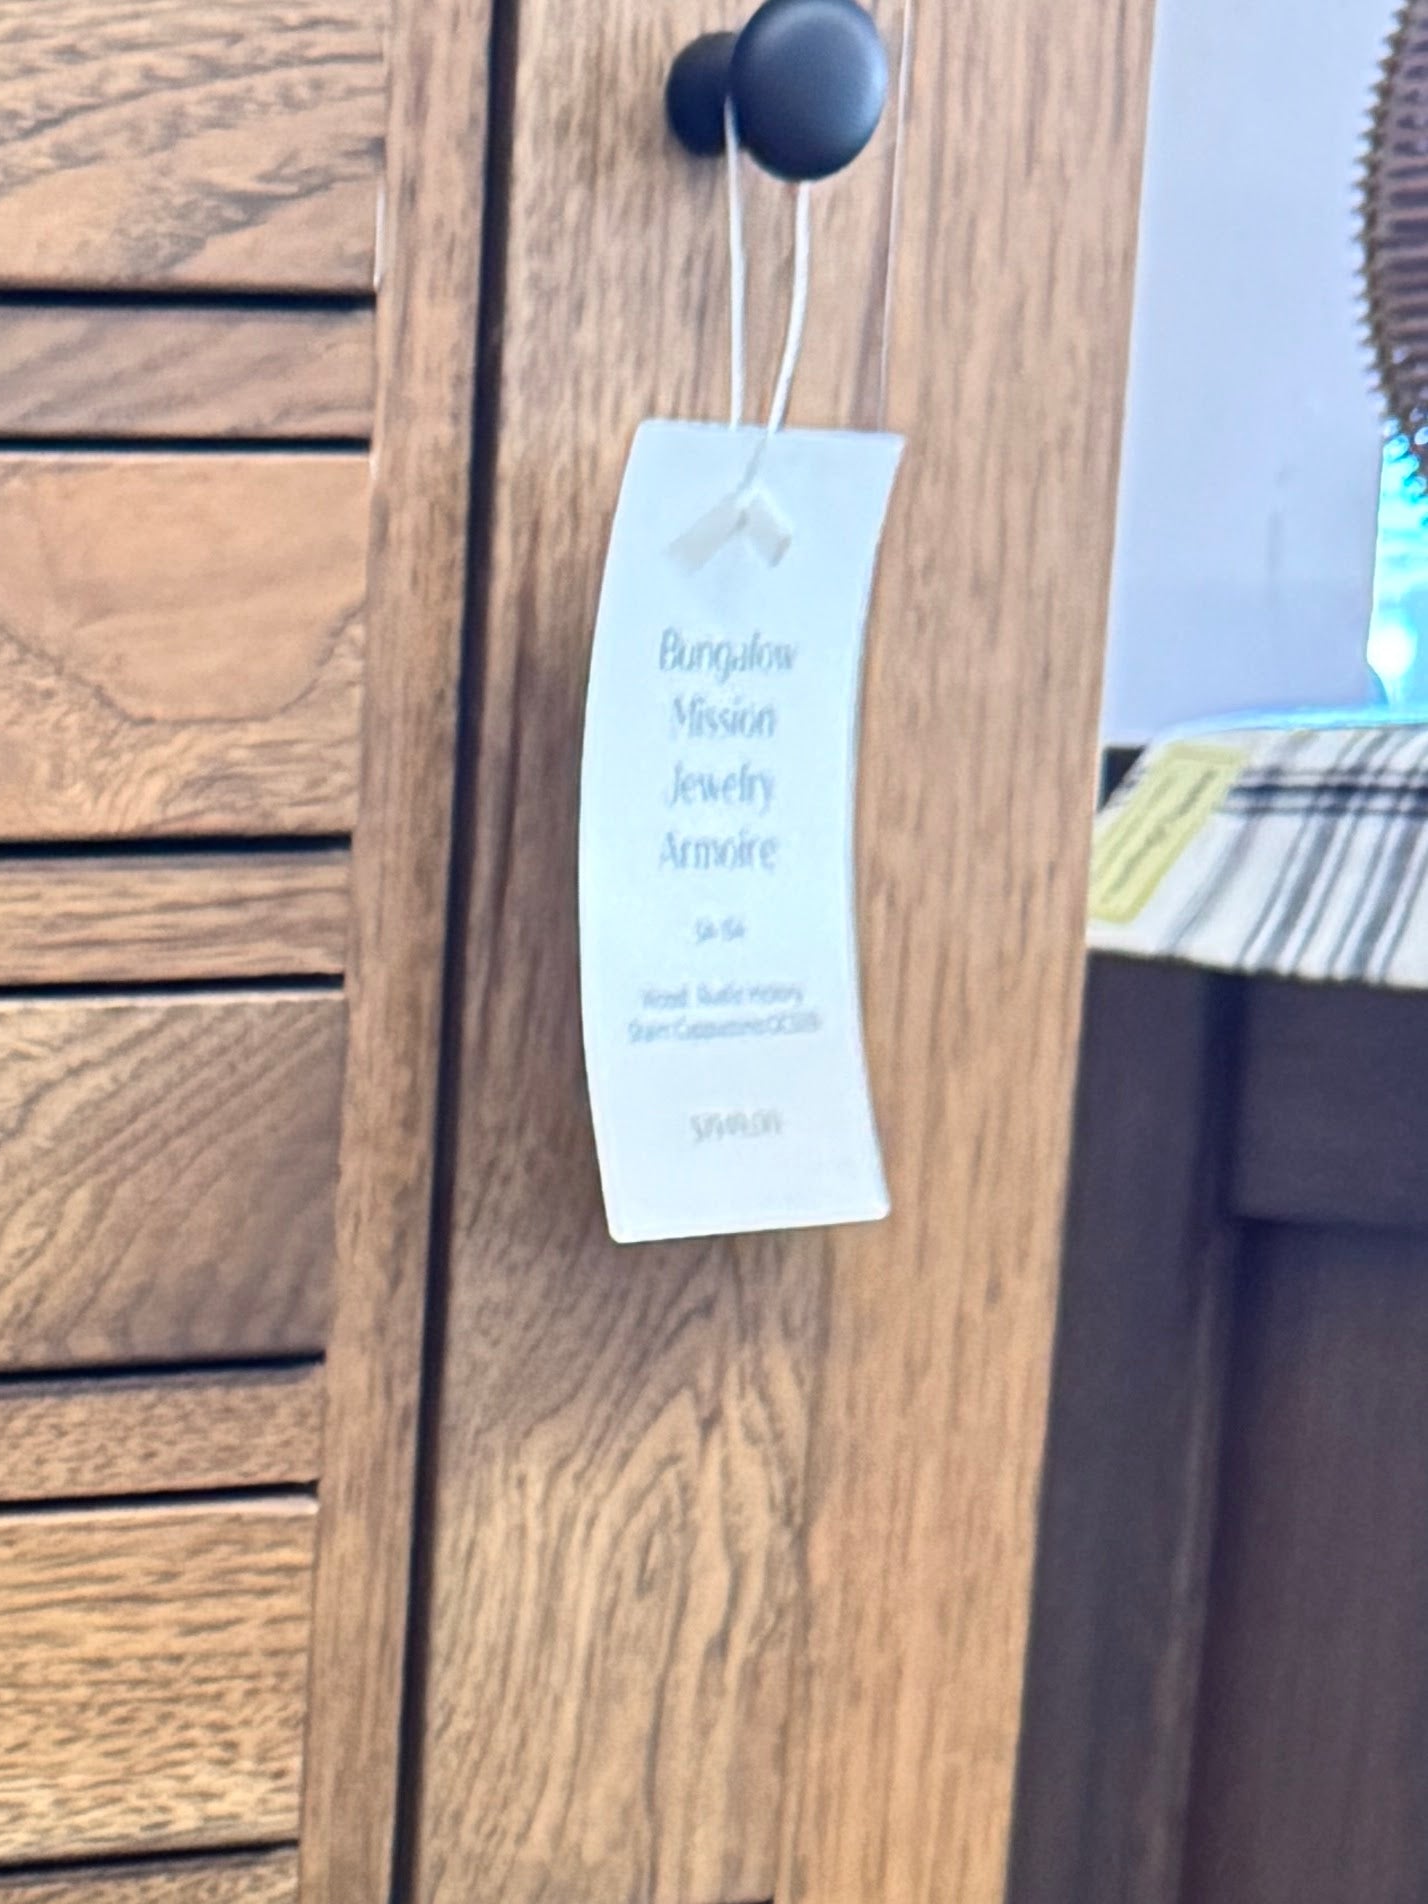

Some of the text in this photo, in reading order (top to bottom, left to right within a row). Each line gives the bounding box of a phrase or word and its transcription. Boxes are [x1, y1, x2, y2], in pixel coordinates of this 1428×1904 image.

[658, 626, 797, 684] Bungalow
[669, 694, 777, 738] Mission
[664, 760, 775, 816] Jewelry
[659, 829, 779, 873] Armoire
